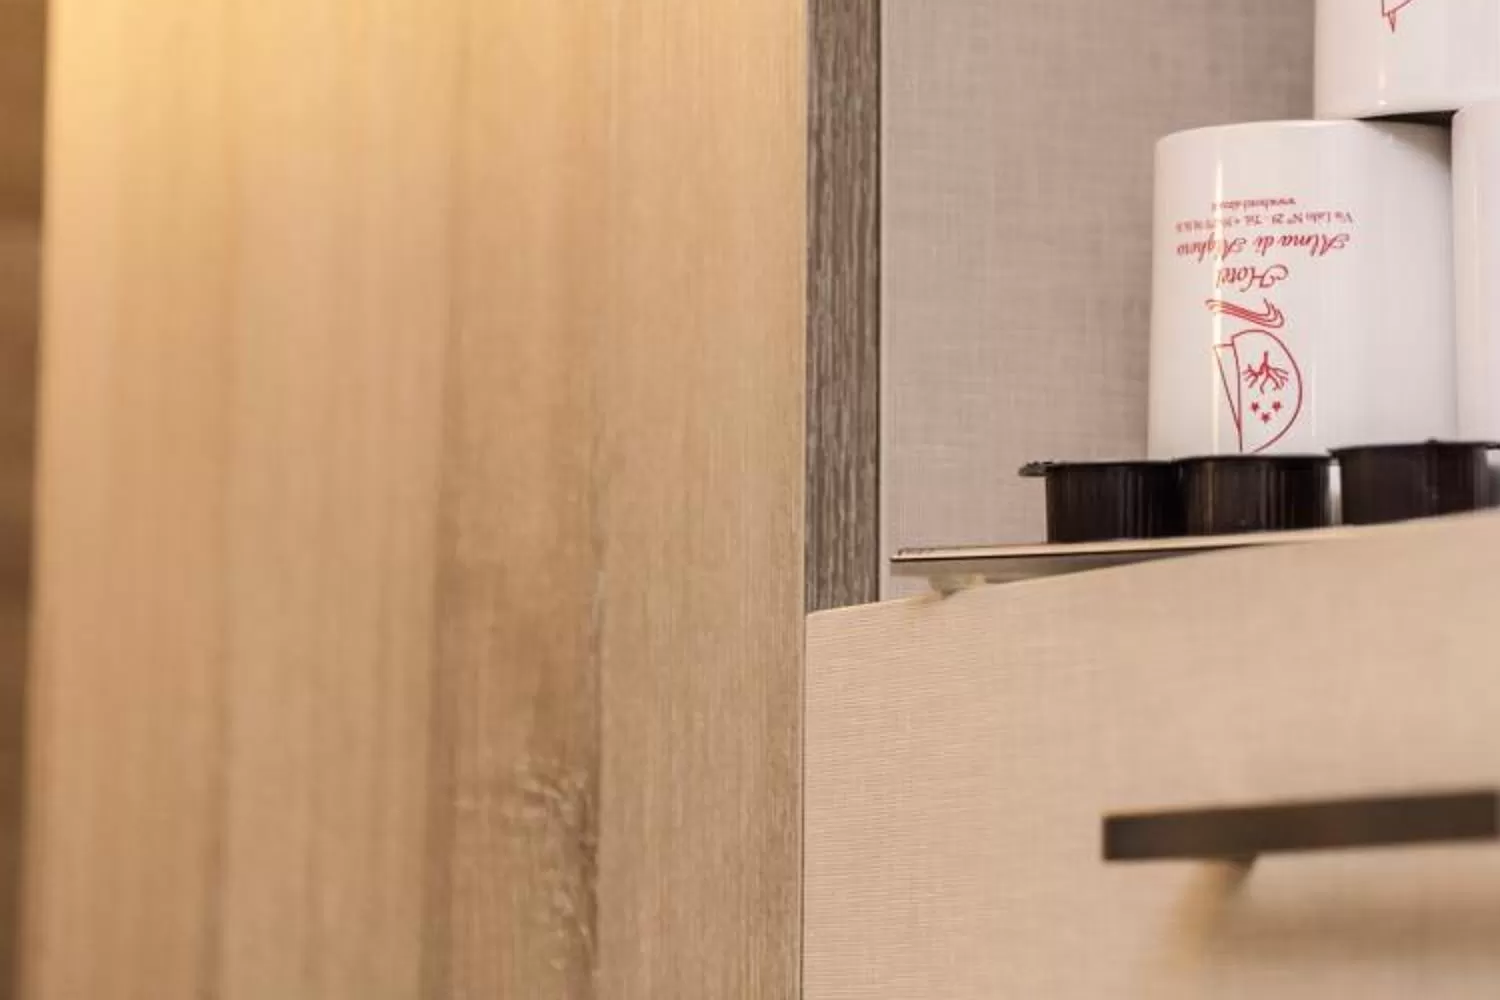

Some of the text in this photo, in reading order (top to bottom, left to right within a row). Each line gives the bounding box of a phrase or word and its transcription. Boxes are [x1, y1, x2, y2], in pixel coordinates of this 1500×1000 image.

[1177, 232, 1350, 263] Alma di Aghero
[1216, 264, 1289, 292] Hotel
